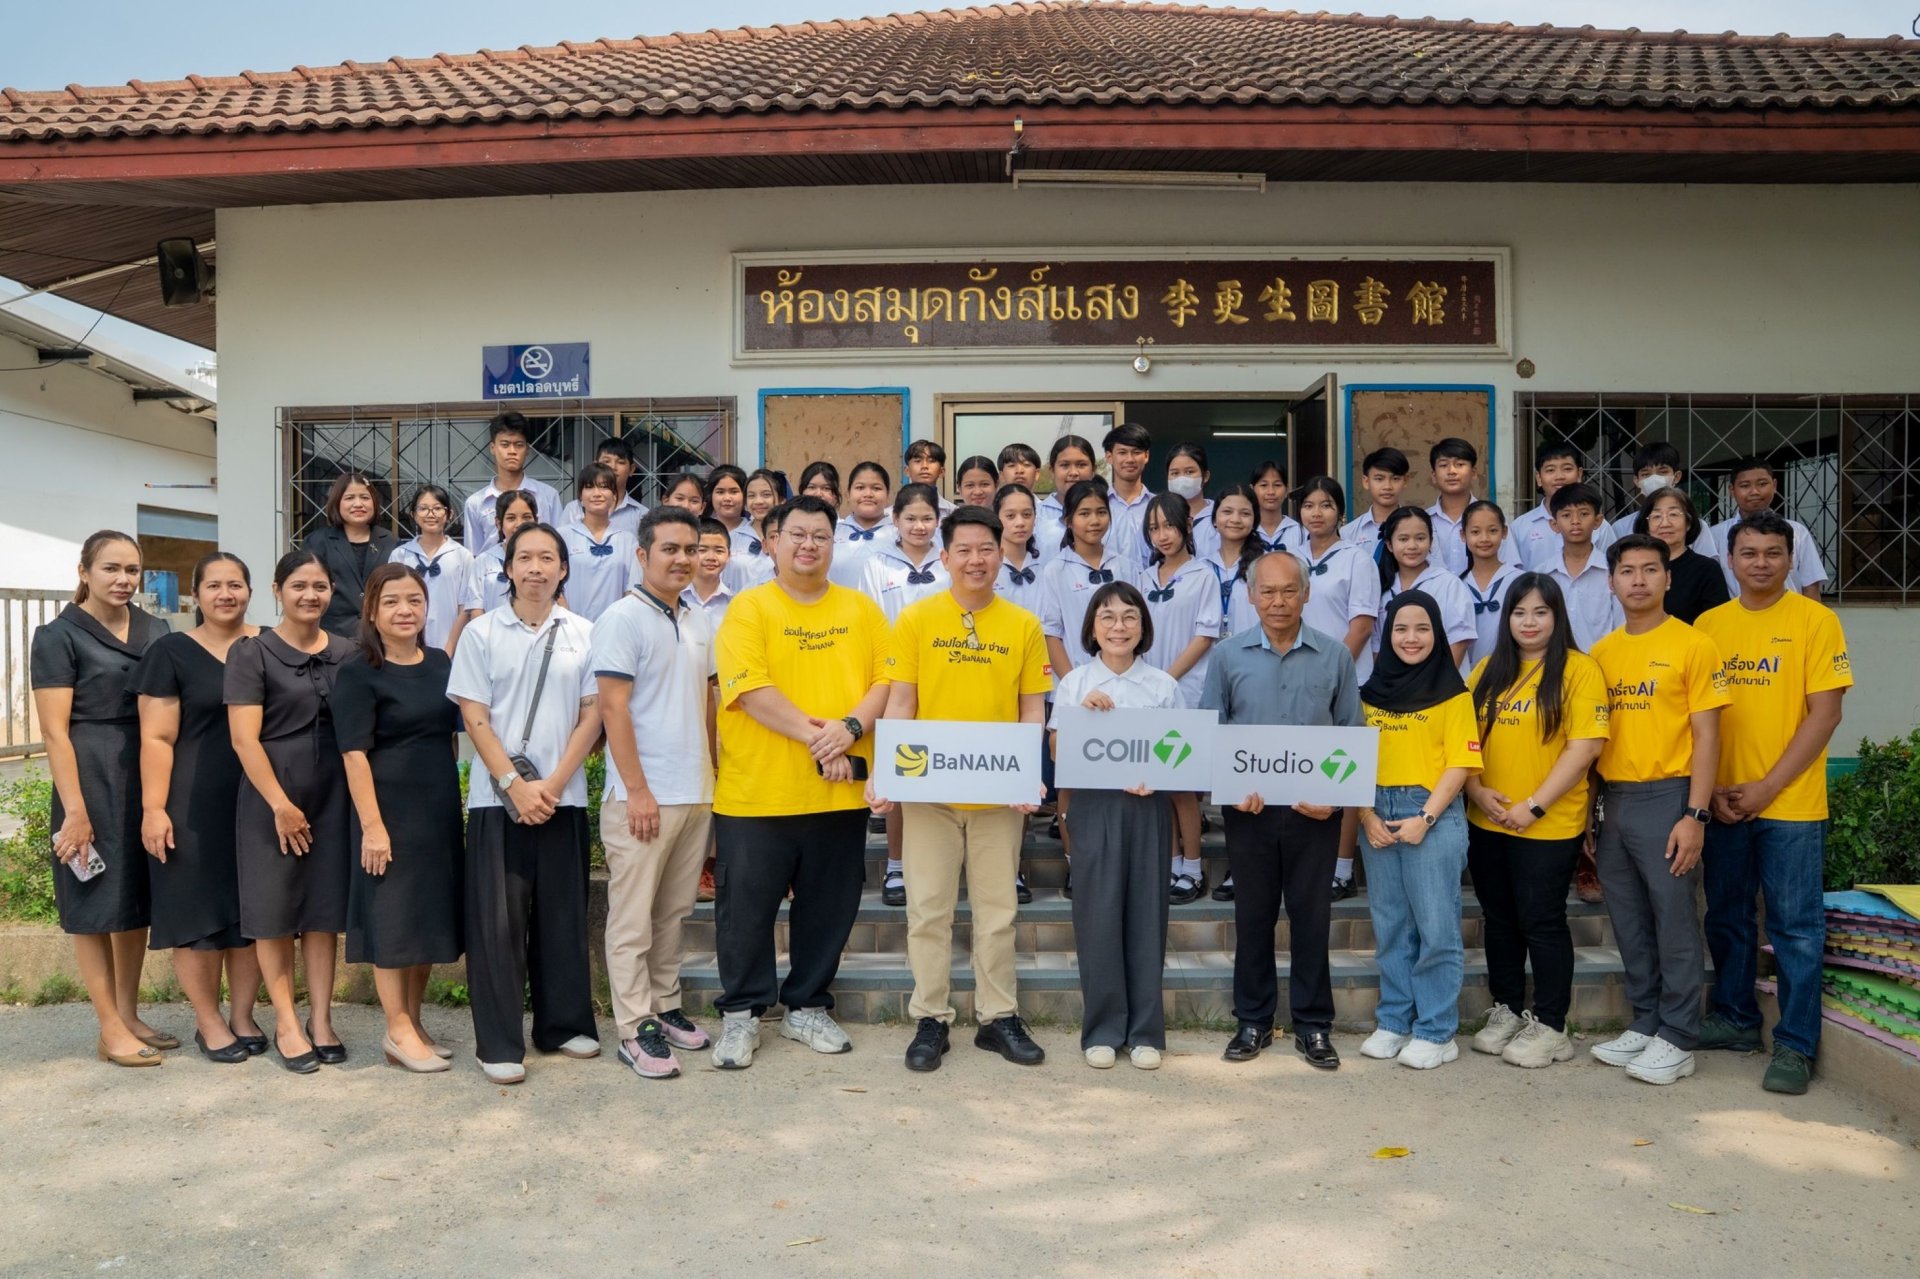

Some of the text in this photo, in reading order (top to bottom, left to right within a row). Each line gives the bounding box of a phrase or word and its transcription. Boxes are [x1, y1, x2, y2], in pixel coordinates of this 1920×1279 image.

[760, 265, 1140, 344] ห้องสมุดกังส์แสง
[1161, 276, 1448, 328] 李更生圖書館
[961, 654, 992, 664] BaNANA
[932, 752, 1021, 772] BaNANA
[1233, 749, 1314, 774] Studio
